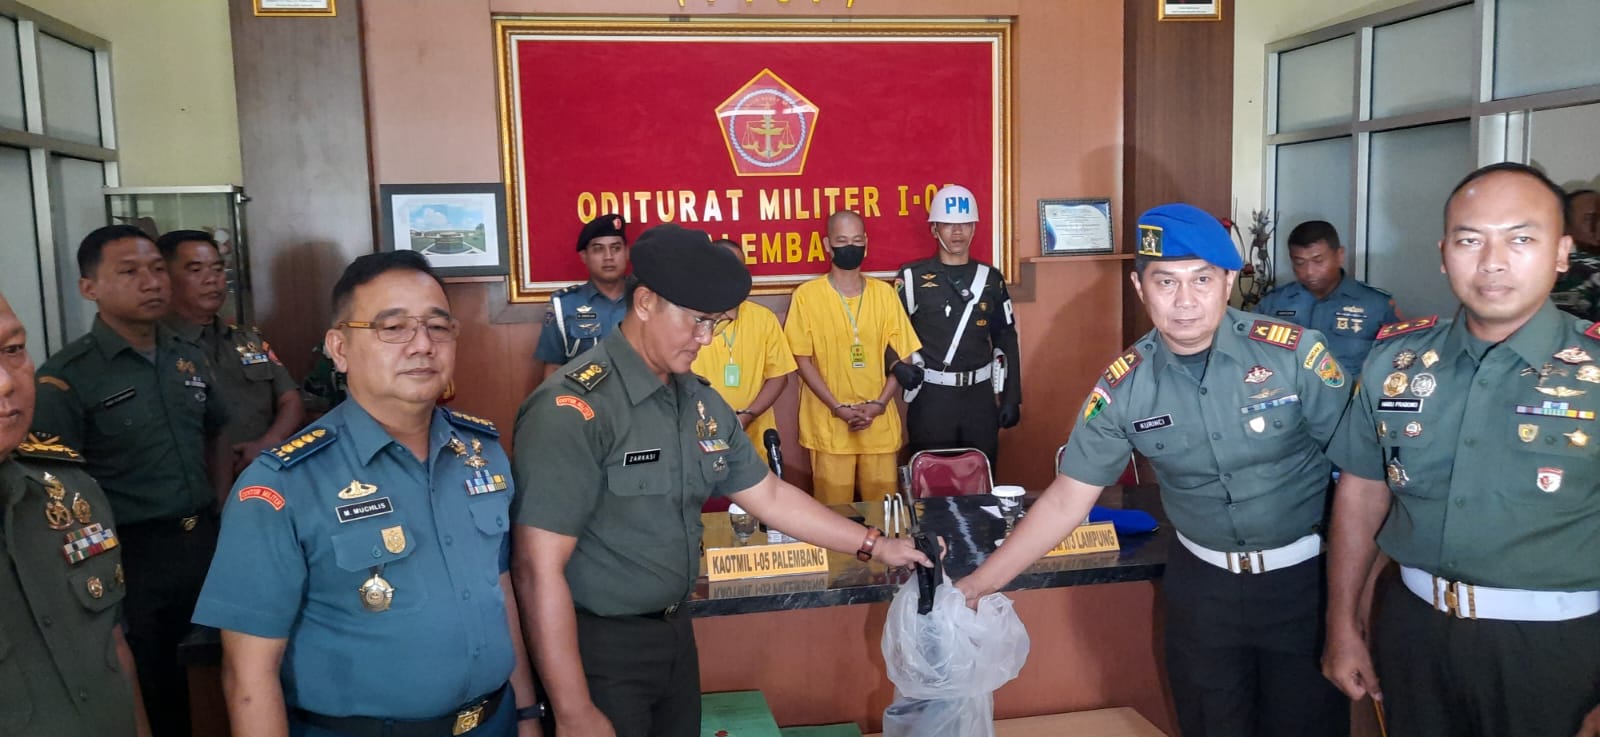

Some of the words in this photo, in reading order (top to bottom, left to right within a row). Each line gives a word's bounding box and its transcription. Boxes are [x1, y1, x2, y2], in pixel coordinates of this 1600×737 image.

[577, 189, 743, 224] ODITURAT
[759, 186, 881, 220] MILITER
[945, 196, 970, 215] PM
[629, 453, 656, 463] ZARKASI
[343, 509, 353, 517] M.
[353, 502, 386, 515] MUCHLIS
[1075, 529, 1115, 550] LAMPUNG
[712, 553, 752, 575] KAOTMIL
[753, 551, 770, 571] I-05
[772, 548, 825, 569] PALEMBANG
